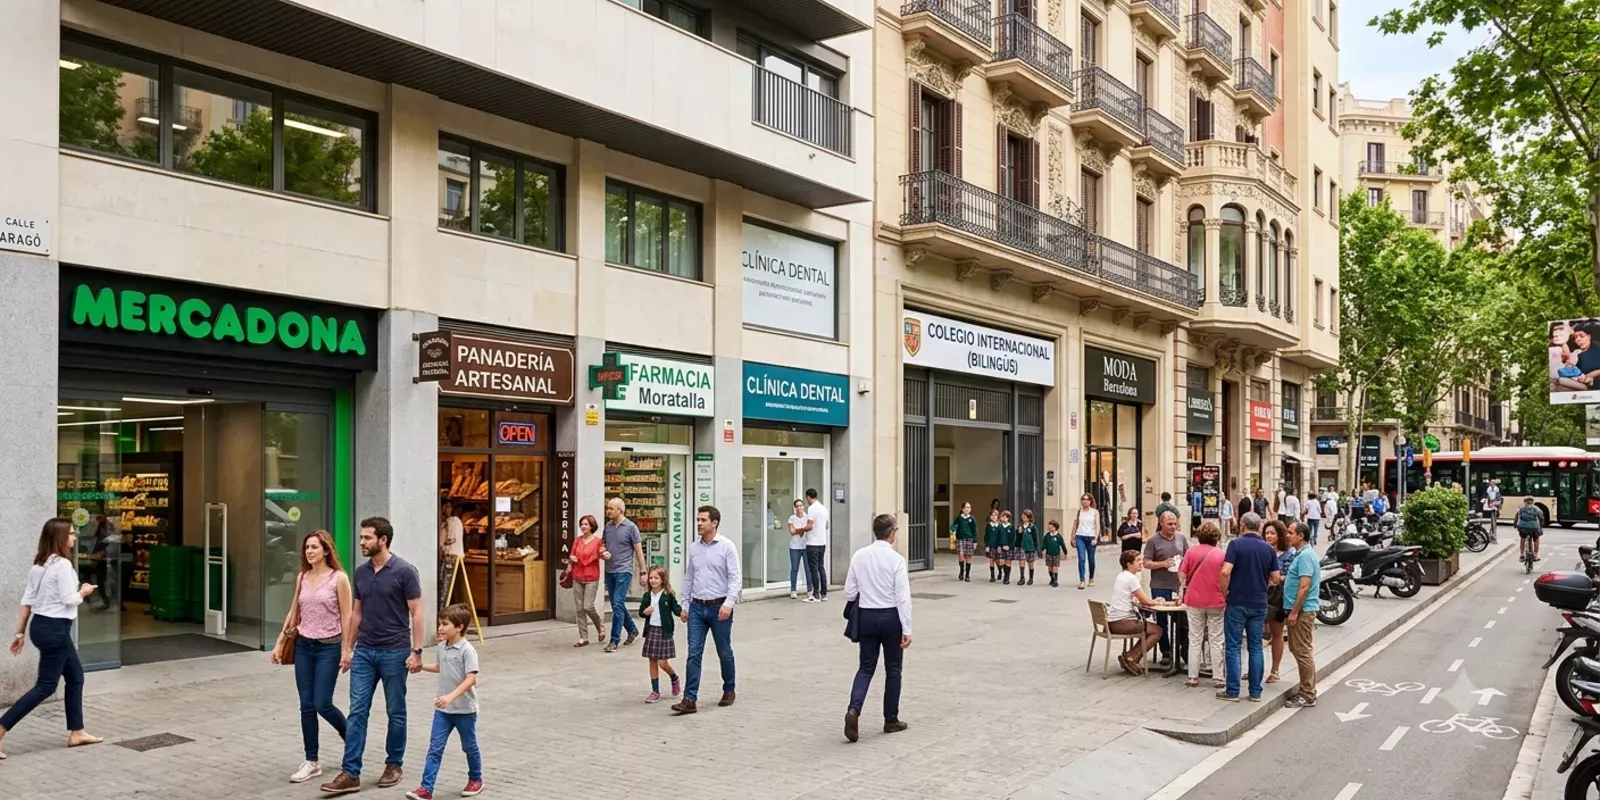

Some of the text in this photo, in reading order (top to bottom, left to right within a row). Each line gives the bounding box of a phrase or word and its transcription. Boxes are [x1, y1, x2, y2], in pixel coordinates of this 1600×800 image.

[5, 217, 35, 229] CALLE
[742, 250, 830, 287] CLÍNICA DENTAL
[73, 284, 366, 356] MERCADONA
[928, 323, 1050, 361] COLEGIO INTERNACIONAL
[457, 345, 555, 372] PANADERÍA
[1103, 356, 1138, 381] MODA
[455, 369, 557, 394] ARTESANAL
[630, 363, 711, 390] FARMACIA
[747, 374, 845, 403] CLÍNICA DENTAL
[639, 387, 705, 410] Moratalla
[500, 424, 534, 442] OPEN
